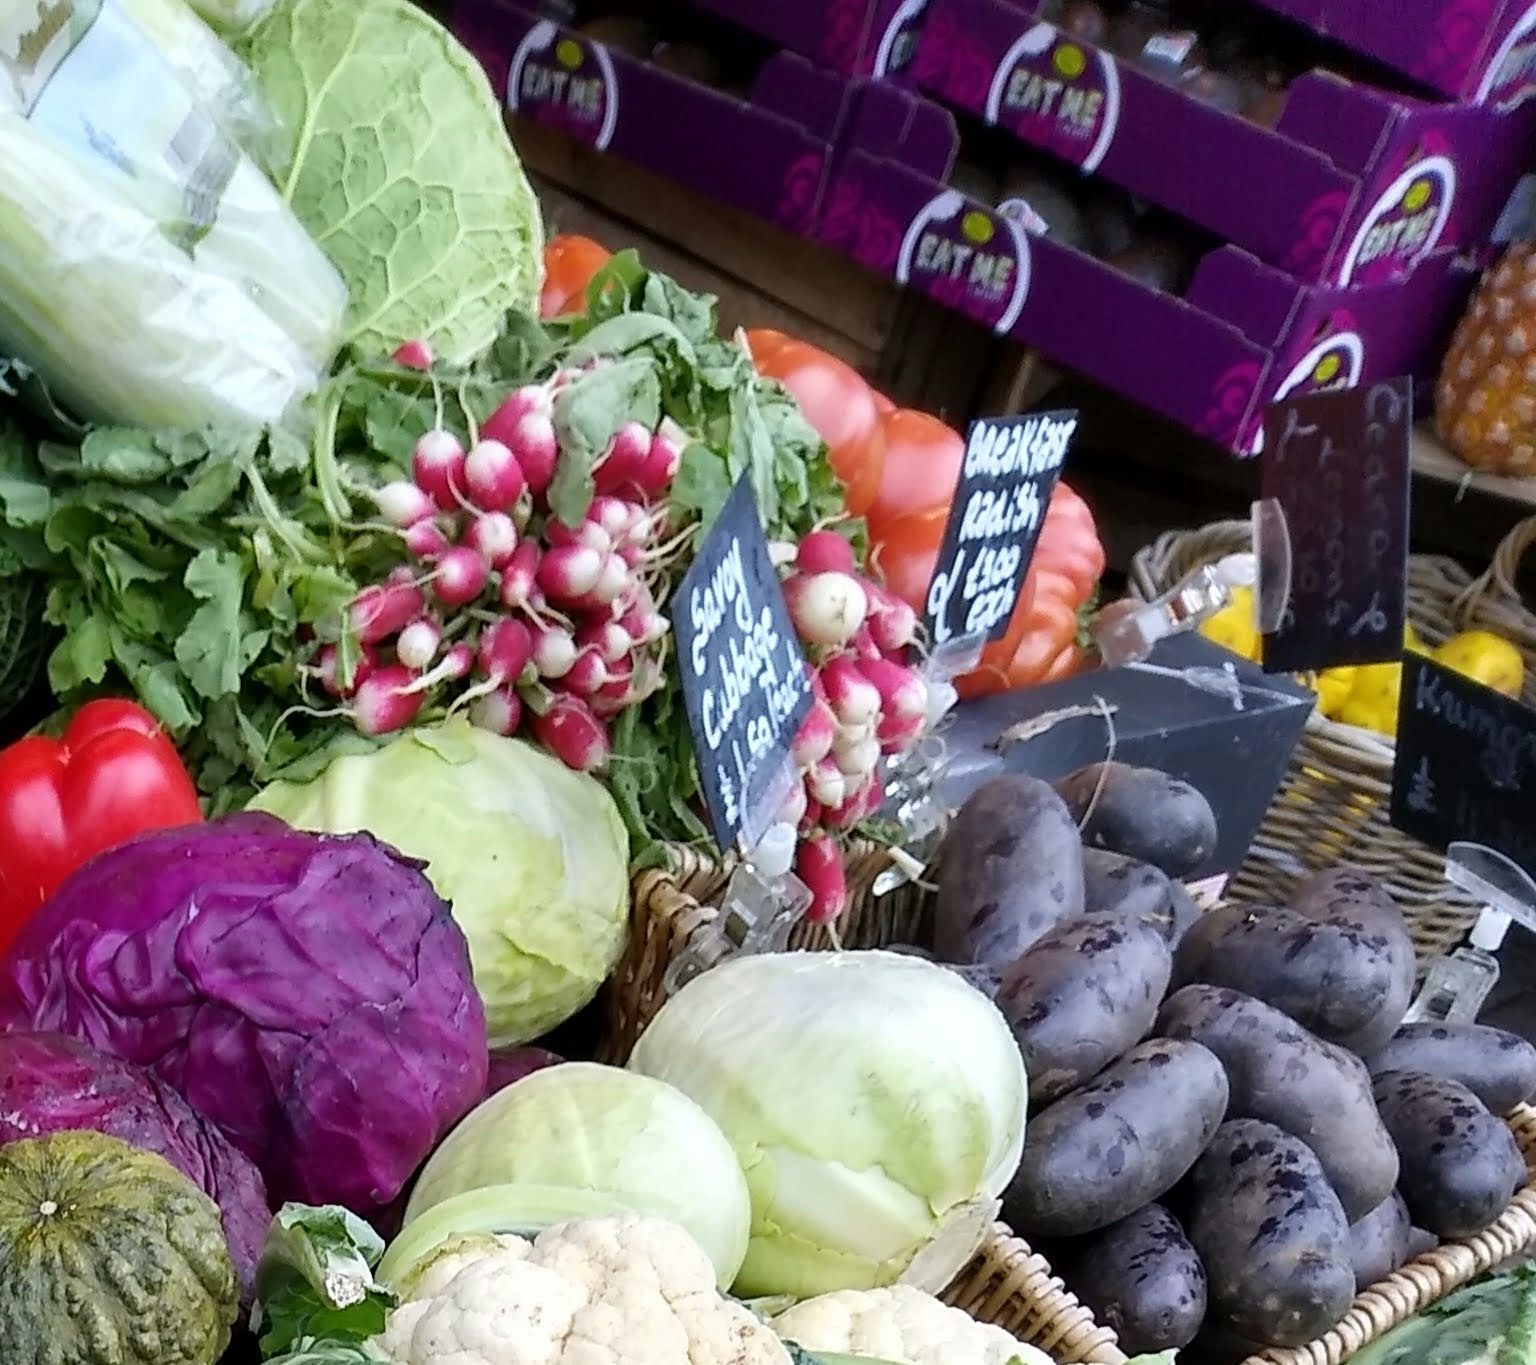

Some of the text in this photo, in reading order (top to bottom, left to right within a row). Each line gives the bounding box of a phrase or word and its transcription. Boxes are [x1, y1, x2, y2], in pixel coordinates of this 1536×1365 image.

[522, 62, 601, 112] EAT ME
[1006, 69, 1103, 126] EAT ME
[916, 233, 1014, 290] EAT ME
[1357, 205, 1438, 265] EAT ME
